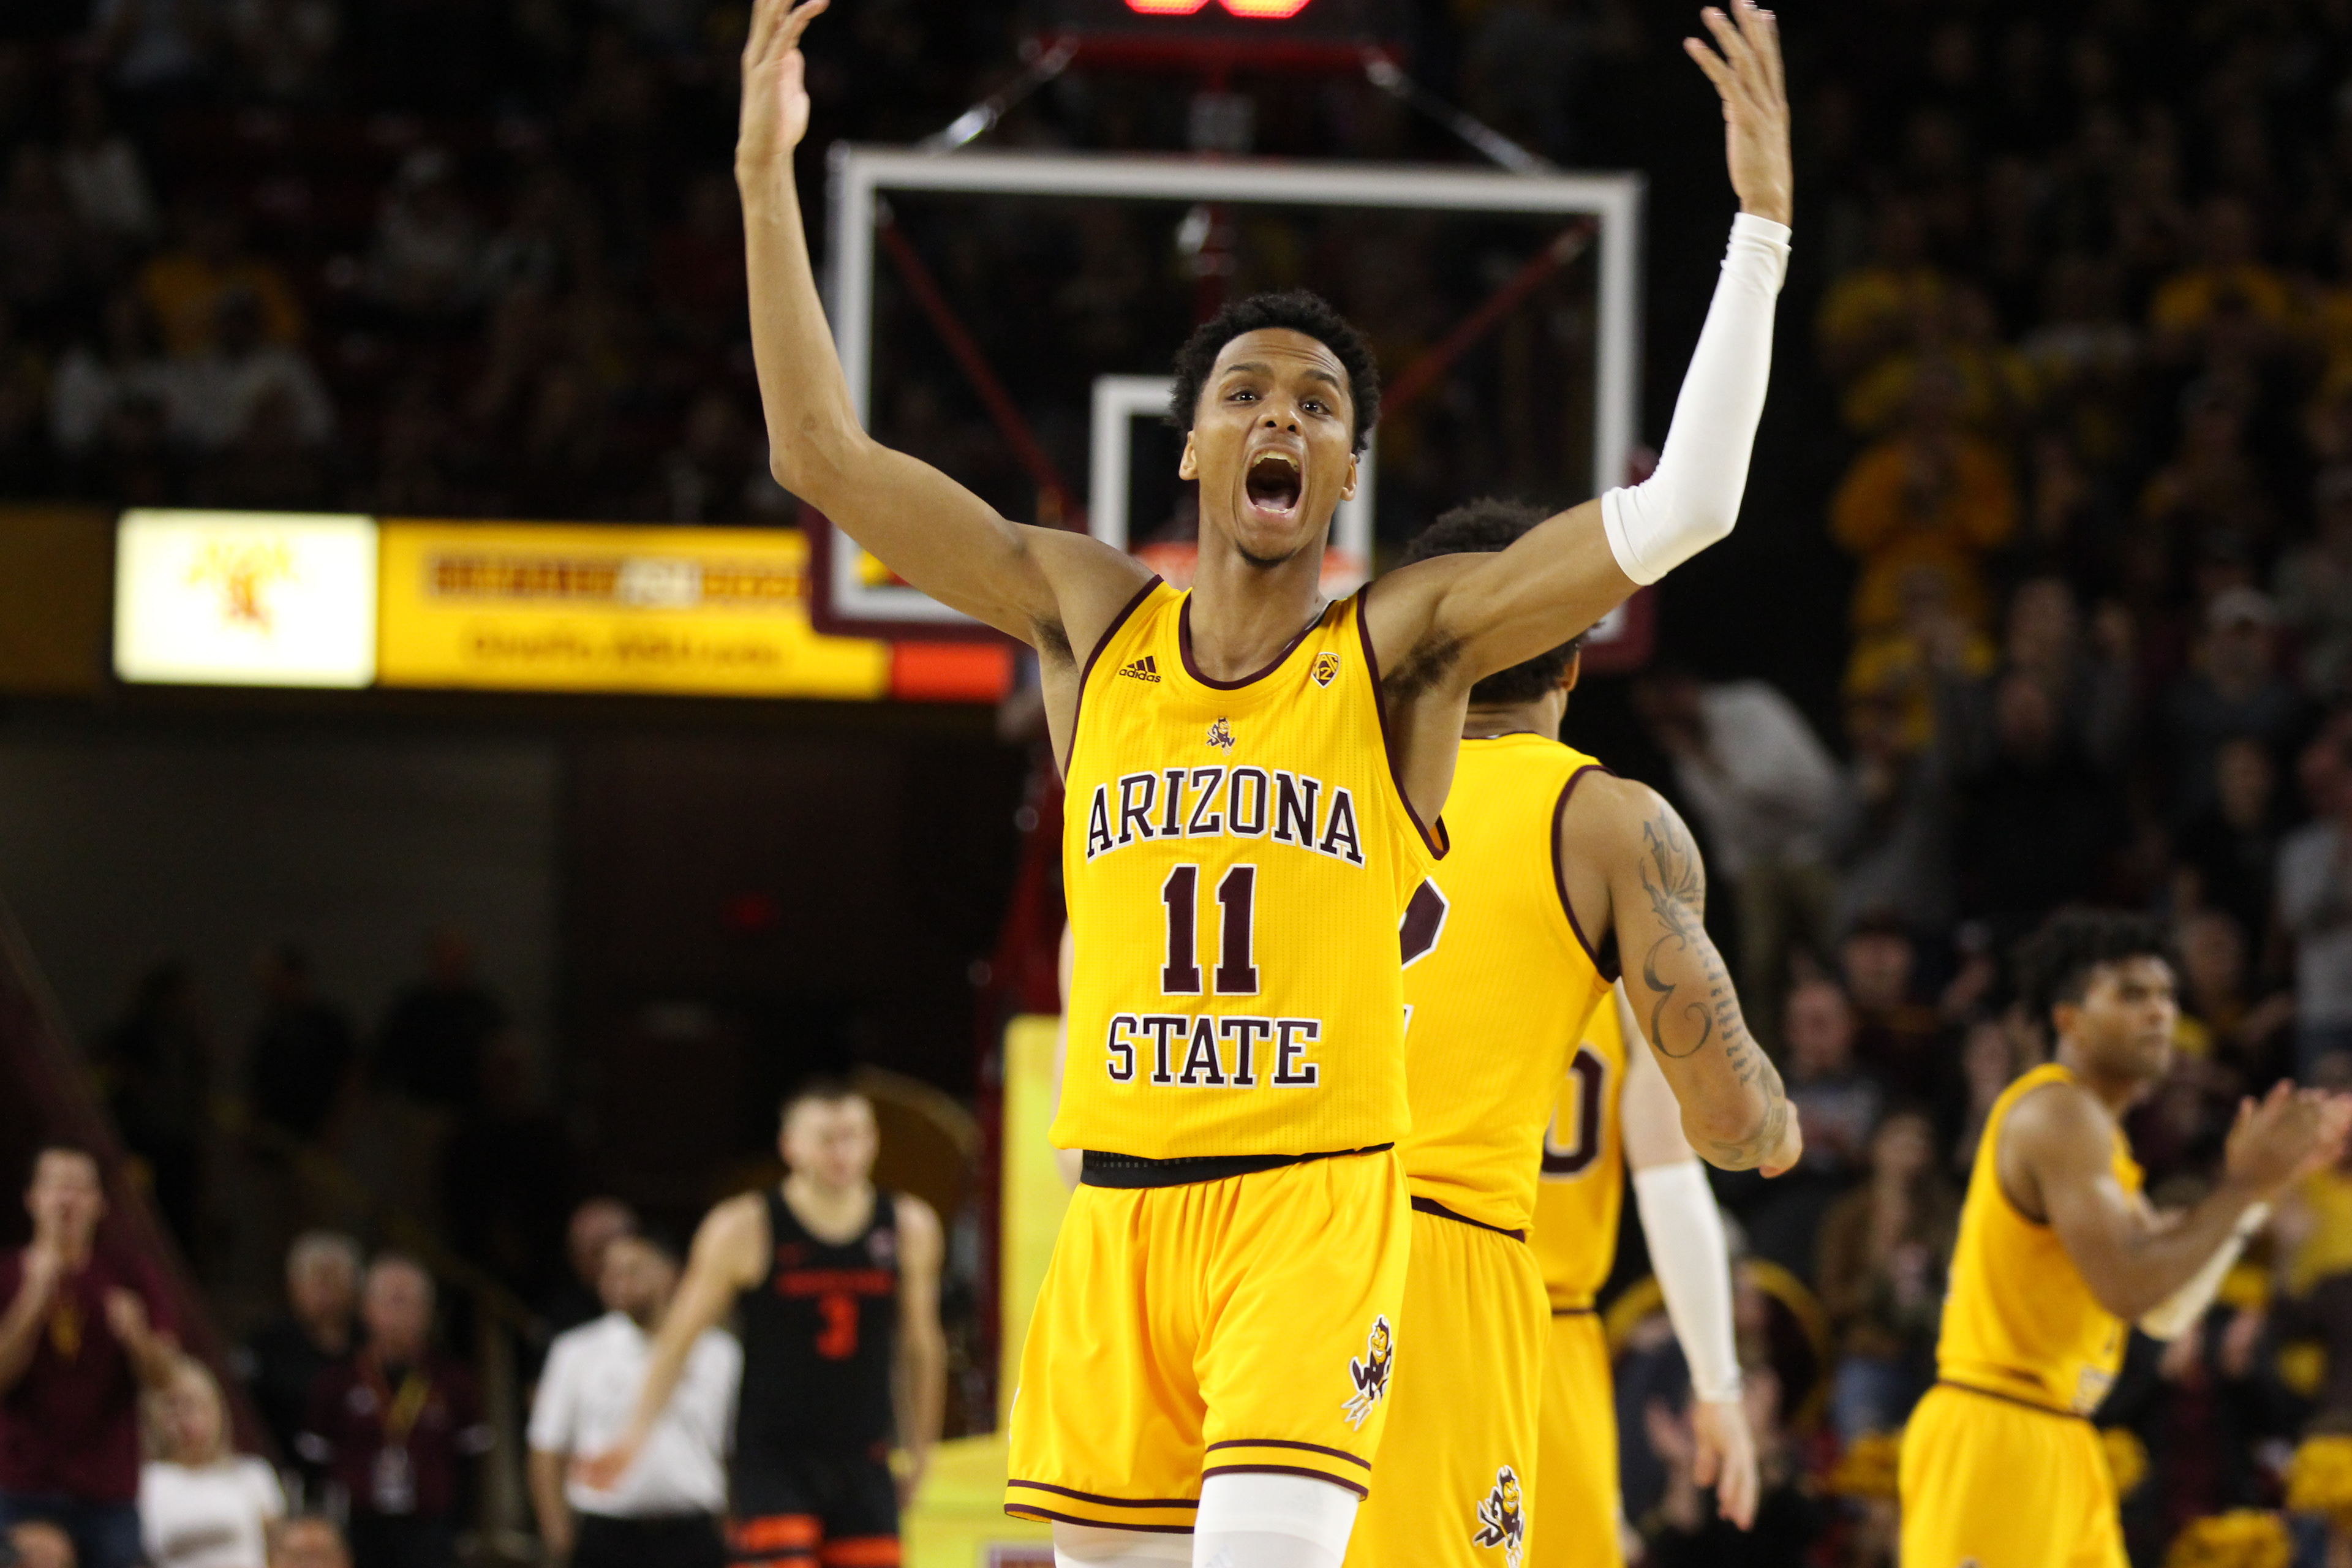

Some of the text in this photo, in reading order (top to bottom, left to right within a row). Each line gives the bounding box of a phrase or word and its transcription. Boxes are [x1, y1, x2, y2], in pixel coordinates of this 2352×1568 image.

[1118, 668, 1161, 683] adidas
[1316, 666, 1332, 680] 12
[1086, 765, 1366, 870] ARIZONA
[1160, 863, 1261, 996] 11
[1106, 1012, 1322, 1088] STATE
[816, 1291, 859, 1360] 3
